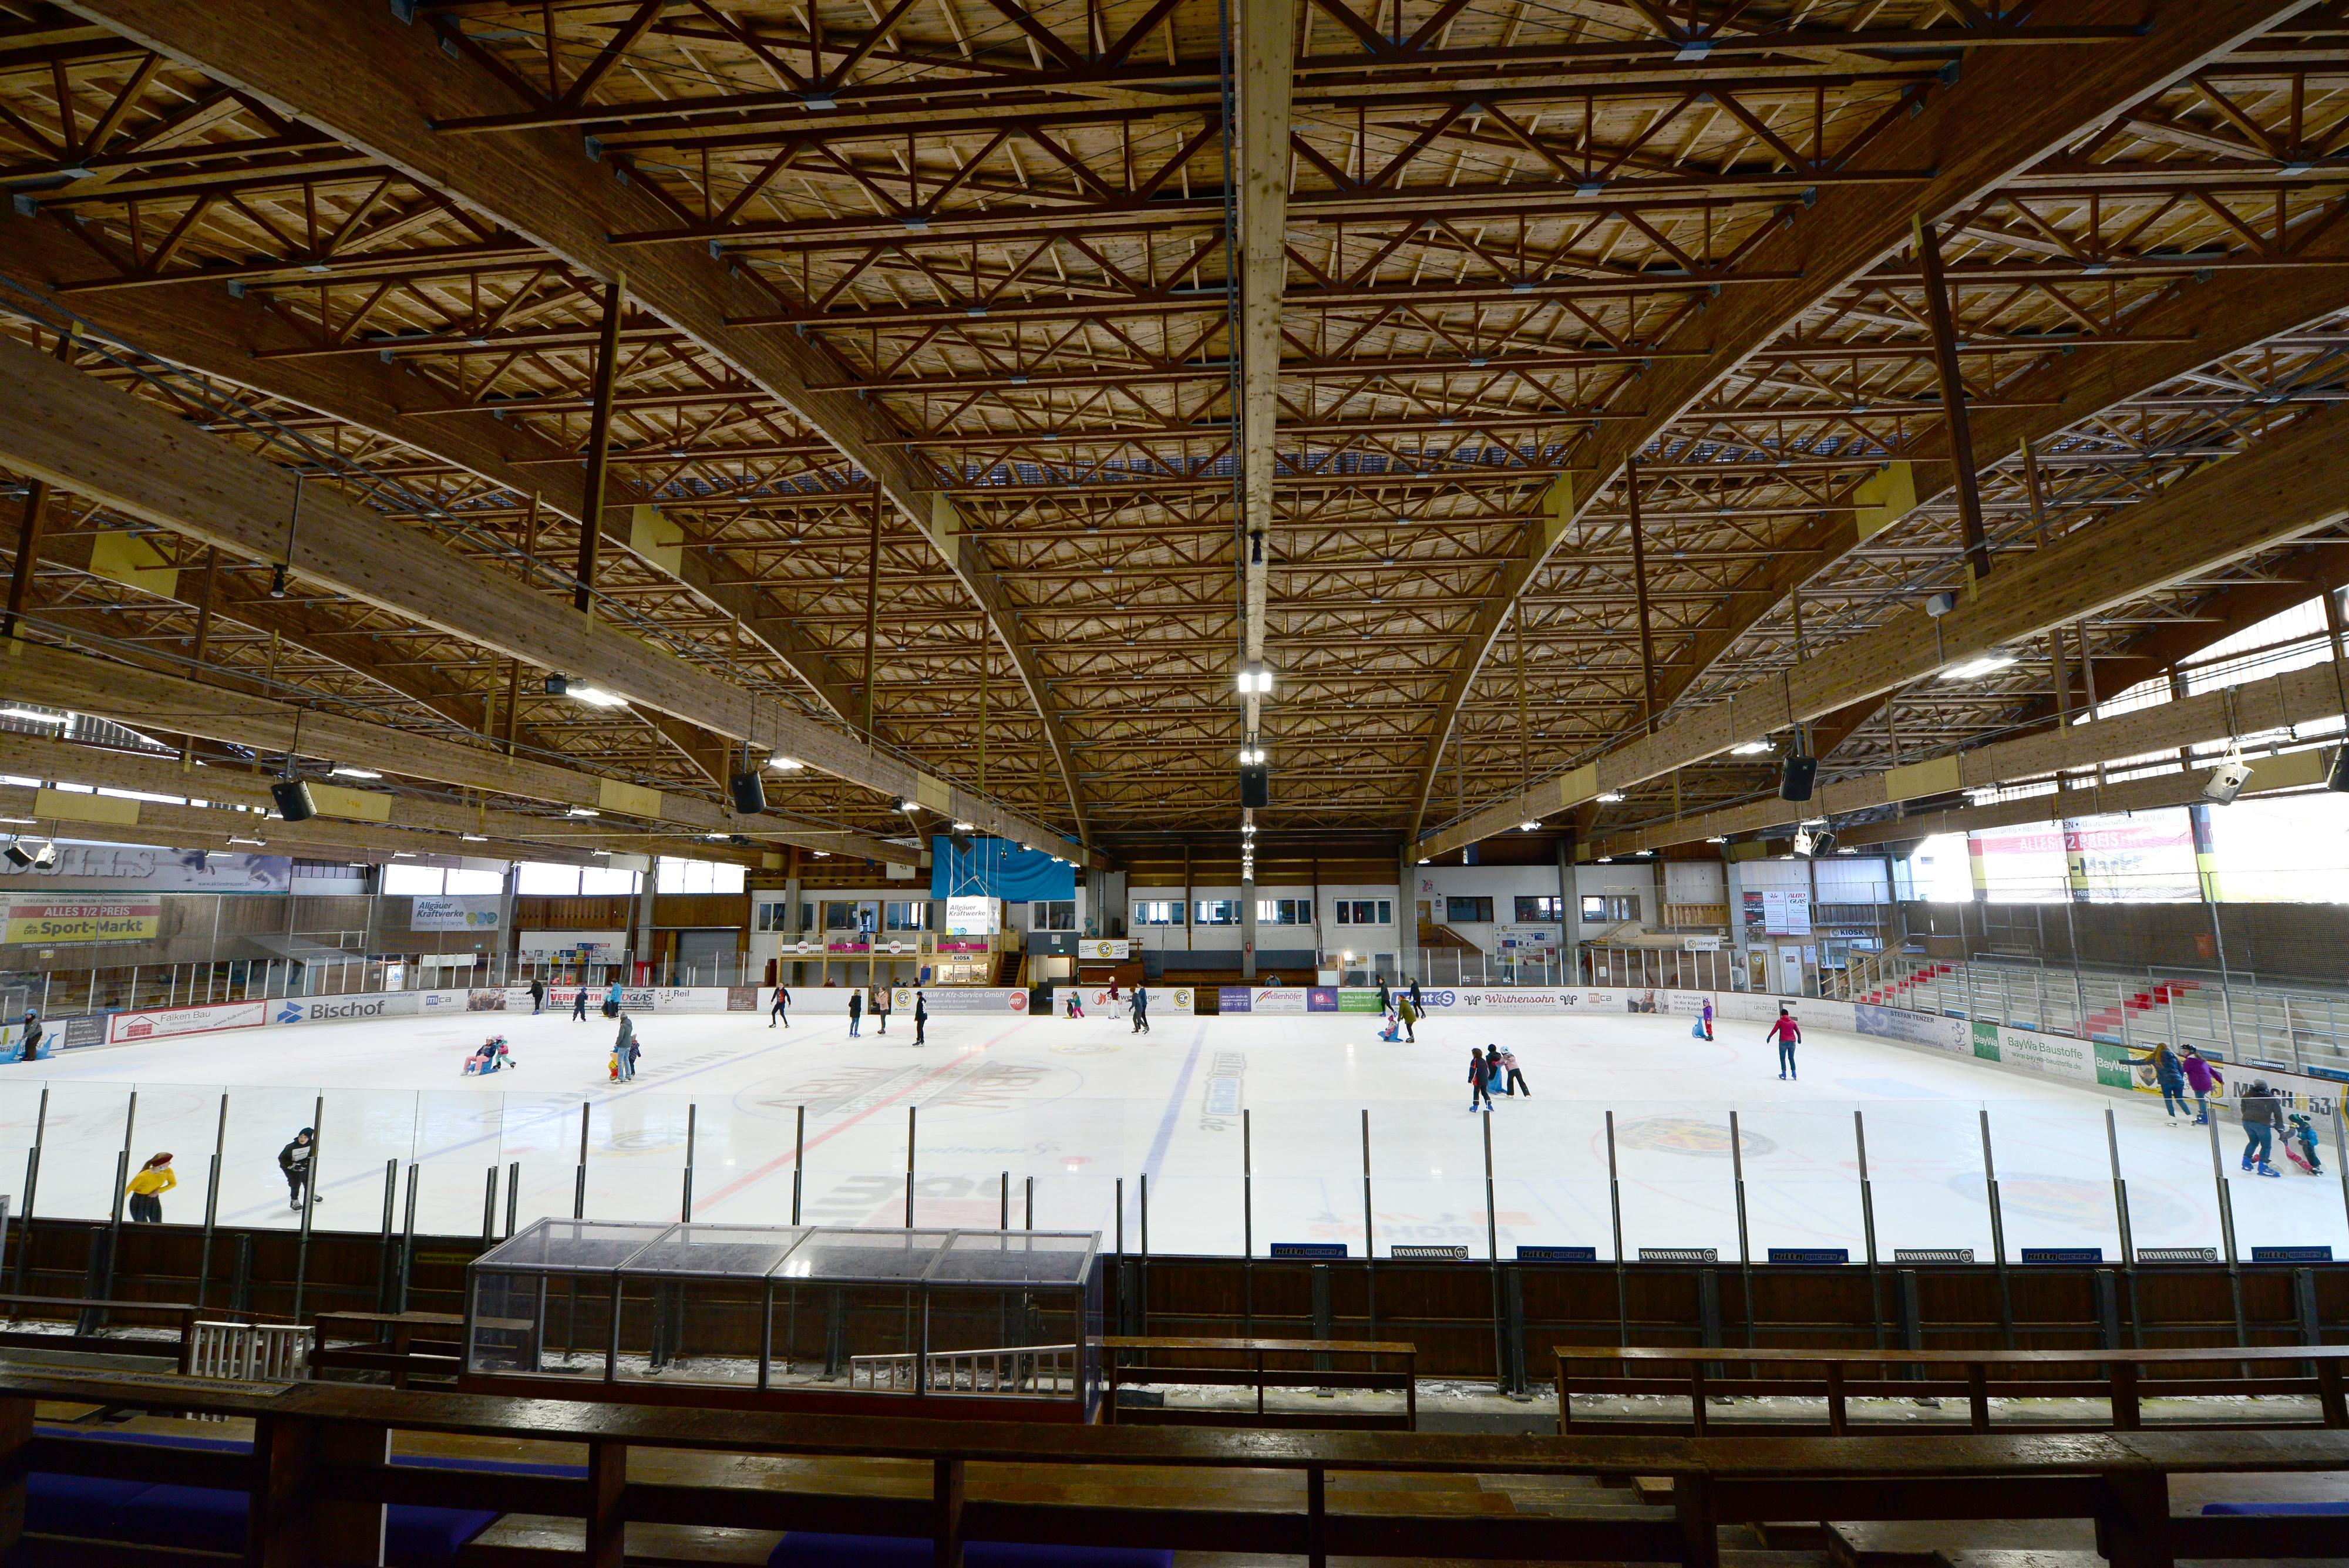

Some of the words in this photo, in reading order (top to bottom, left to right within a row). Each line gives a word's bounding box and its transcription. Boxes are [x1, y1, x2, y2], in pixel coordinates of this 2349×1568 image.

[44, 907, 79, 917] ALLES
[82, 907, 97, 916] 1/2
[419, 902, 453, 911] Allgäuer
[41, 919, 143, 936] Sport-Markt
[1264, 992, 1302, 1001] Wellenhöfer
[1485, 994, 1556, 1003] Wirthensohn
[160, 1013, 190, 1022] Falken
[193, 1011, 211, 1019] Bau
[213, 1004, 262, 1027] www.falkenbau.de
[310, 1001, 385, 1019] Bischof
[1890, 1010, 1911, 1019] STEFAN
[1912, 1014, 1934, 1024] TENZER
[1973, 1034, 1998, 1047] BayWa
[2008, 1037, 2037, 1051] BayWa
[2039, 1042, 2083, 1059] Baustoffe
[2011, 1051, 2082, 1071] www.baywa-baustoffe.de
[2097, 1056, 2129, 1073] BayWa
[2253, 1060, 2284, 1069] WARRIOR
